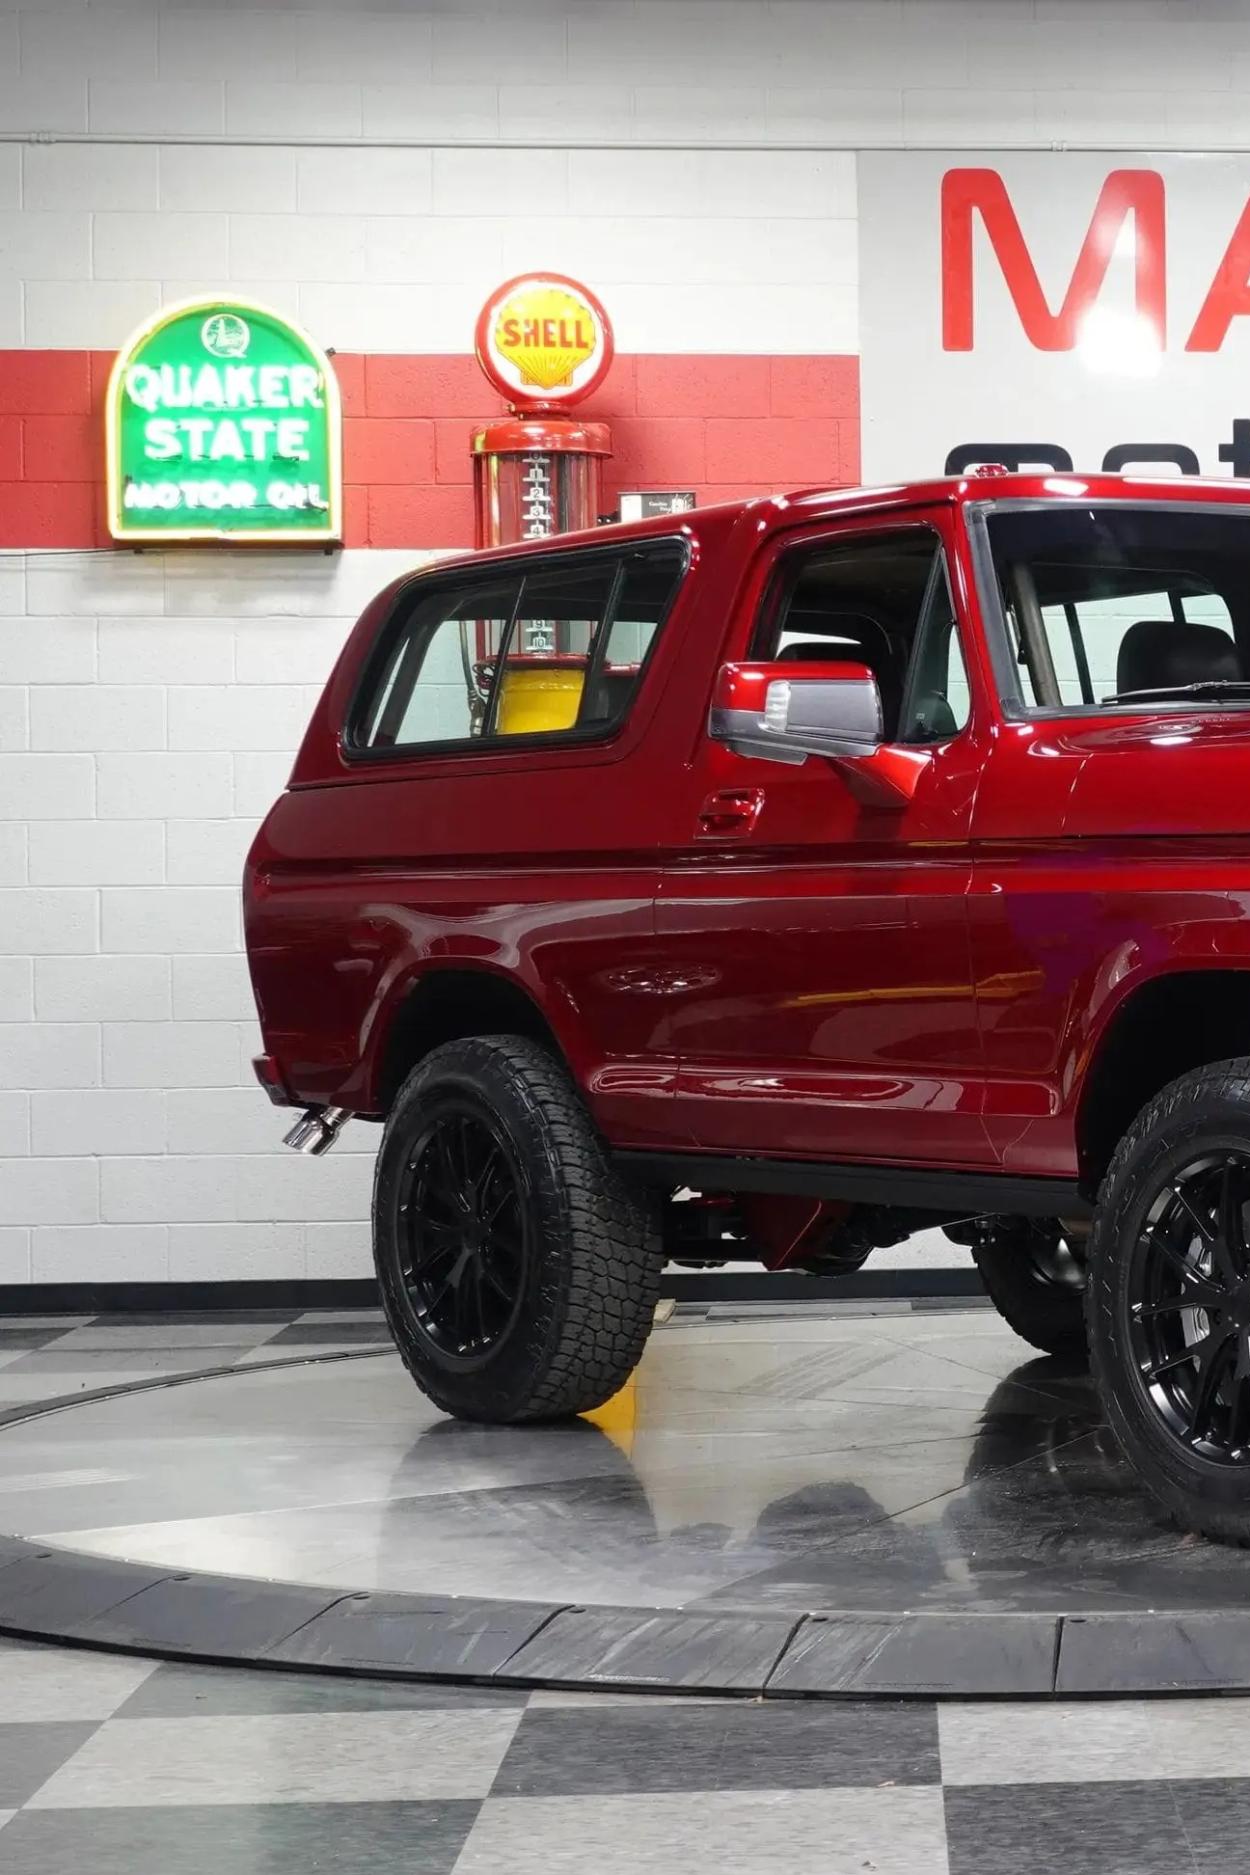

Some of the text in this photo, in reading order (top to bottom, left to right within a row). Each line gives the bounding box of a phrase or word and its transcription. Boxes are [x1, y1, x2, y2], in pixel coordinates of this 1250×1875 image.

[503, 318, 589, 349] SHELL
[125, 362, 325, 413] QUAKER
[144, 418, 310, 461] STATE
[124, 480, 328, 511] MOTOR OIL
[533, 488, 540, 498] 2
[533, 507, 540, 517] 3
[533, 526, 540, 535] 4
[533, 638, 545, 648] 10
